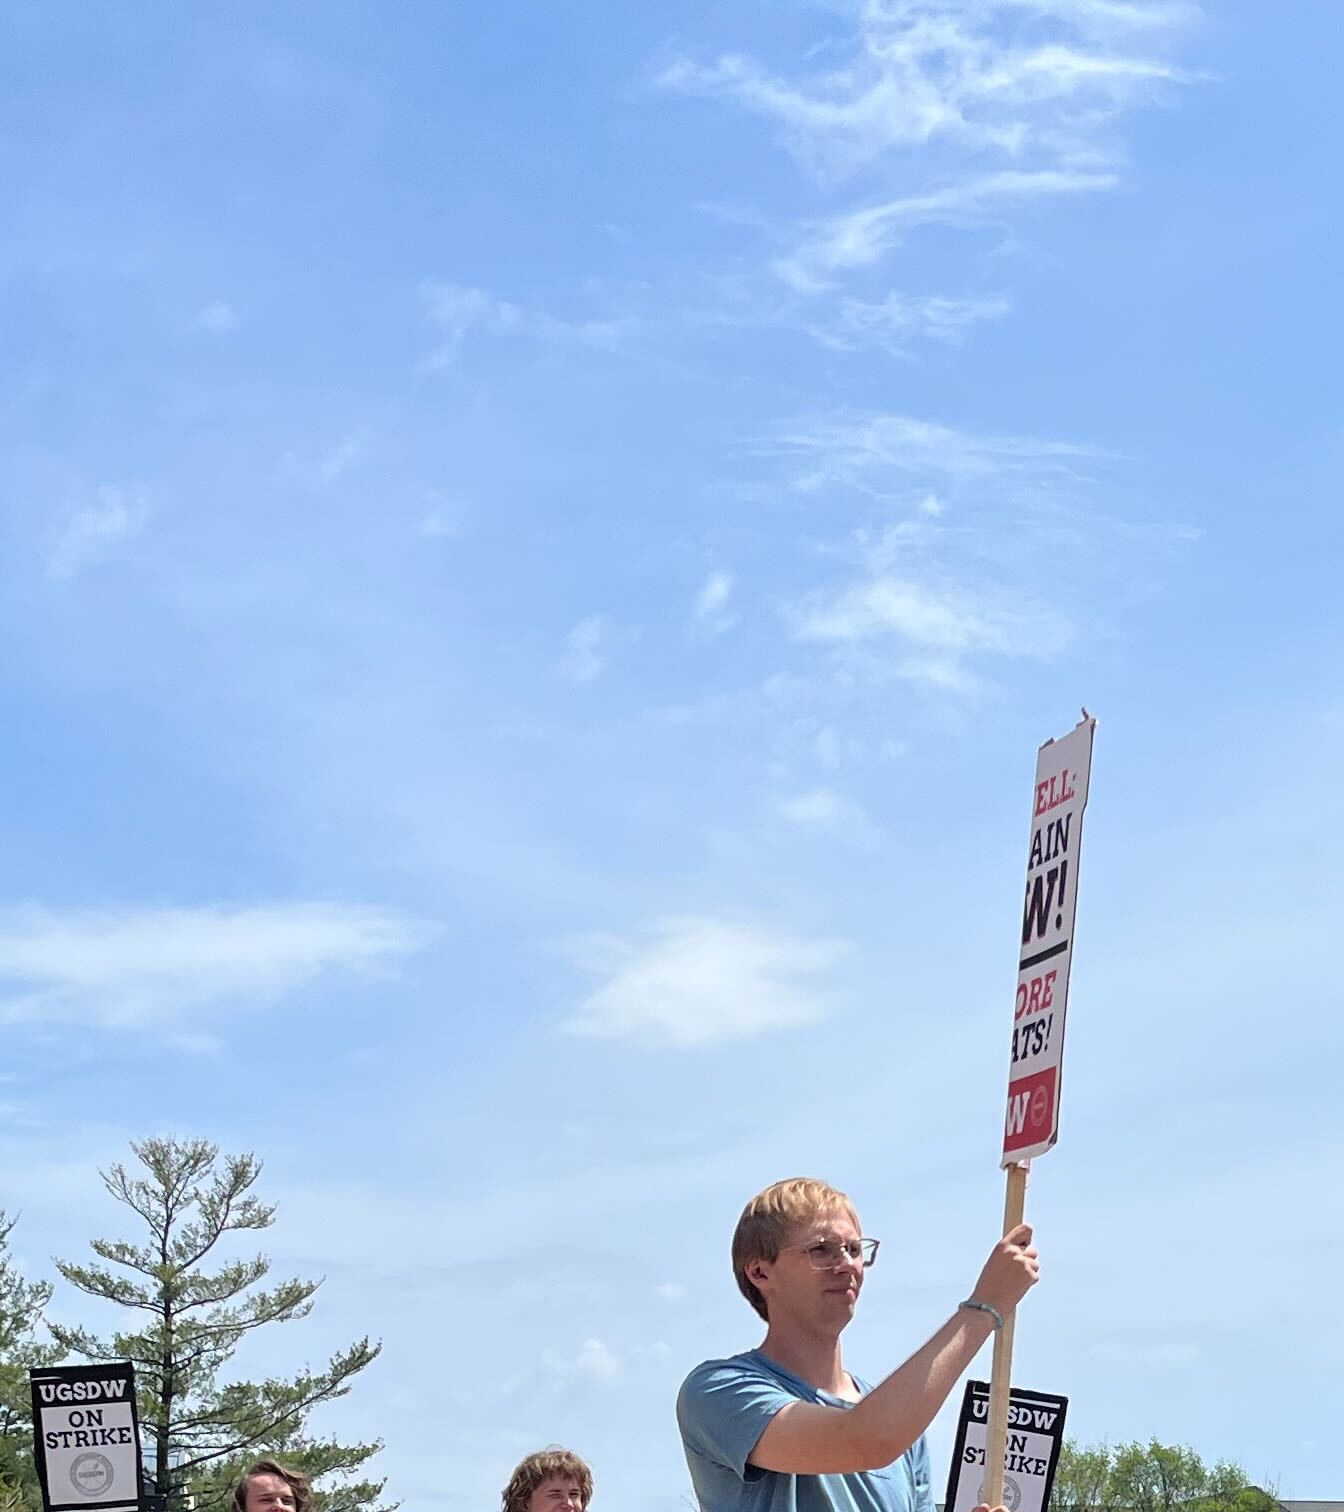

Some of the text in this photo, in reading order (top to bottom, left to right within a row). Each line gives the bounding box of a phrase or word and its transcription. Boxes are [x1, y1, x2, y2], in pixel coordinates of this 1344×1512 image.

[39, 1379, 127, 1402] UGSDW
[68, 1409, 103, 1428] ON
[972, 1400, 1057, 1430] USDW
[46, 1427, 132, 1449] STRIKE
[1006, 1434, 1028, 1453] N
[963, 1446, 1047, 1476] STIKE
